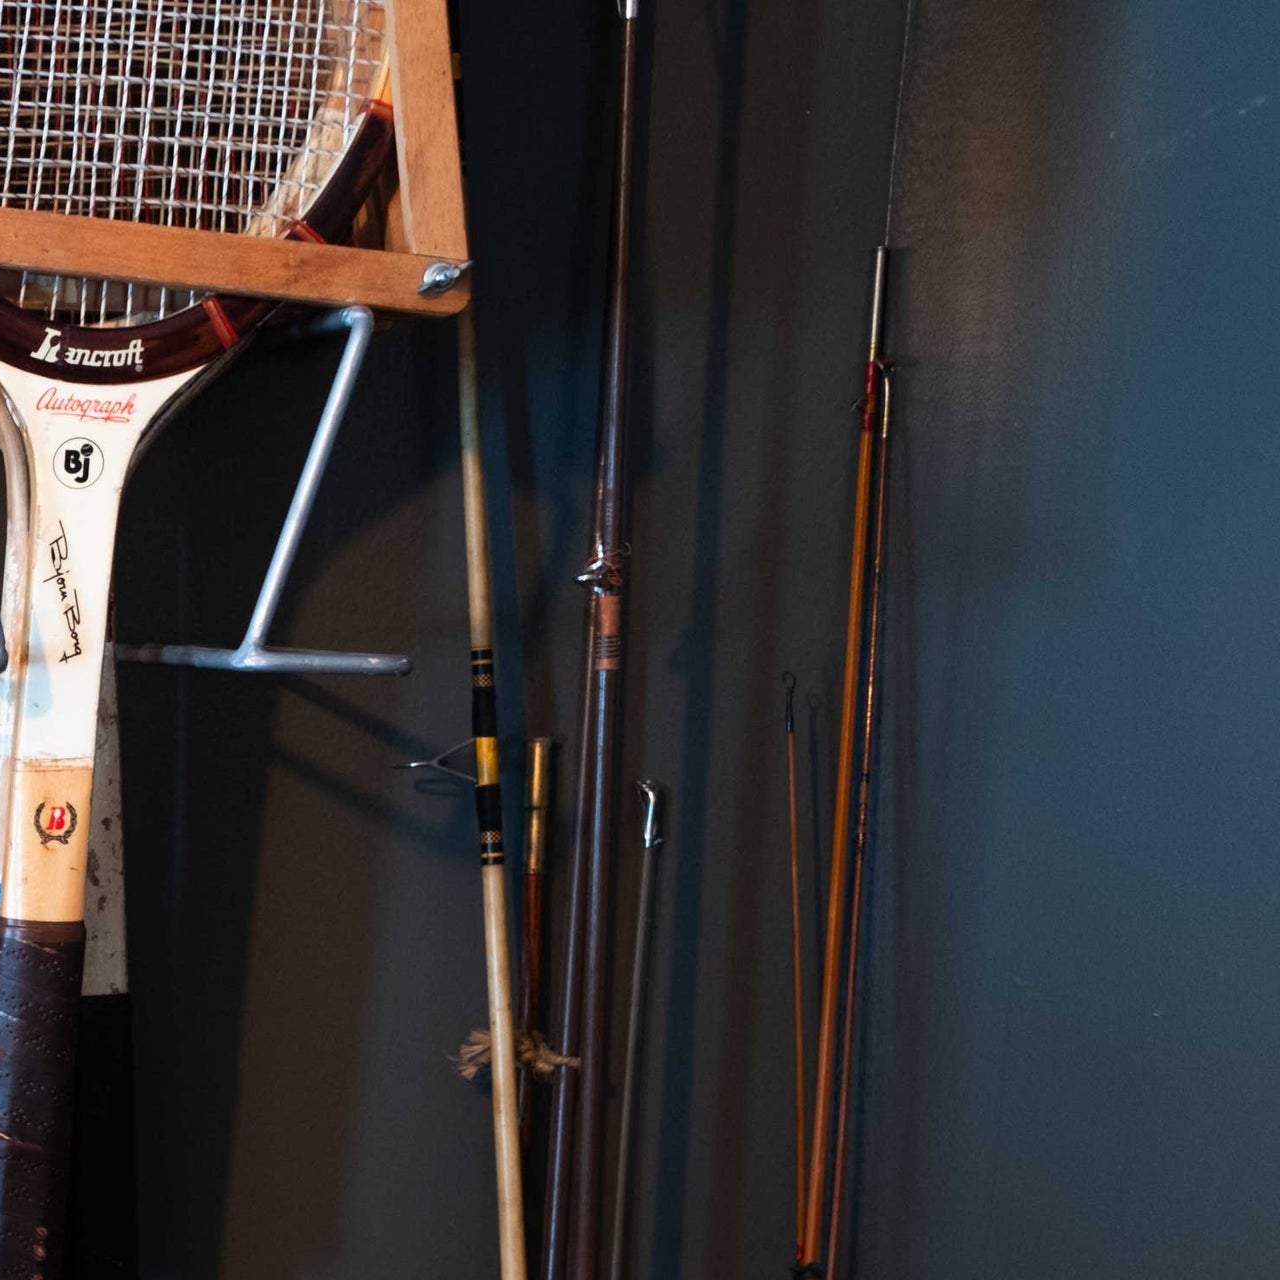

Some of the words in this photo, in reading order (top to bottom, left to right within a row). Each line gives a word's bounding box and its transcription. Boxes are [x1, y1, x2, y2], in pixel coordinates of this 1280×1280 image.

[36, 387, 137, 423] Autograph
[64, 443, 94, 483] Bj
[45, 806, 66, 830] B
